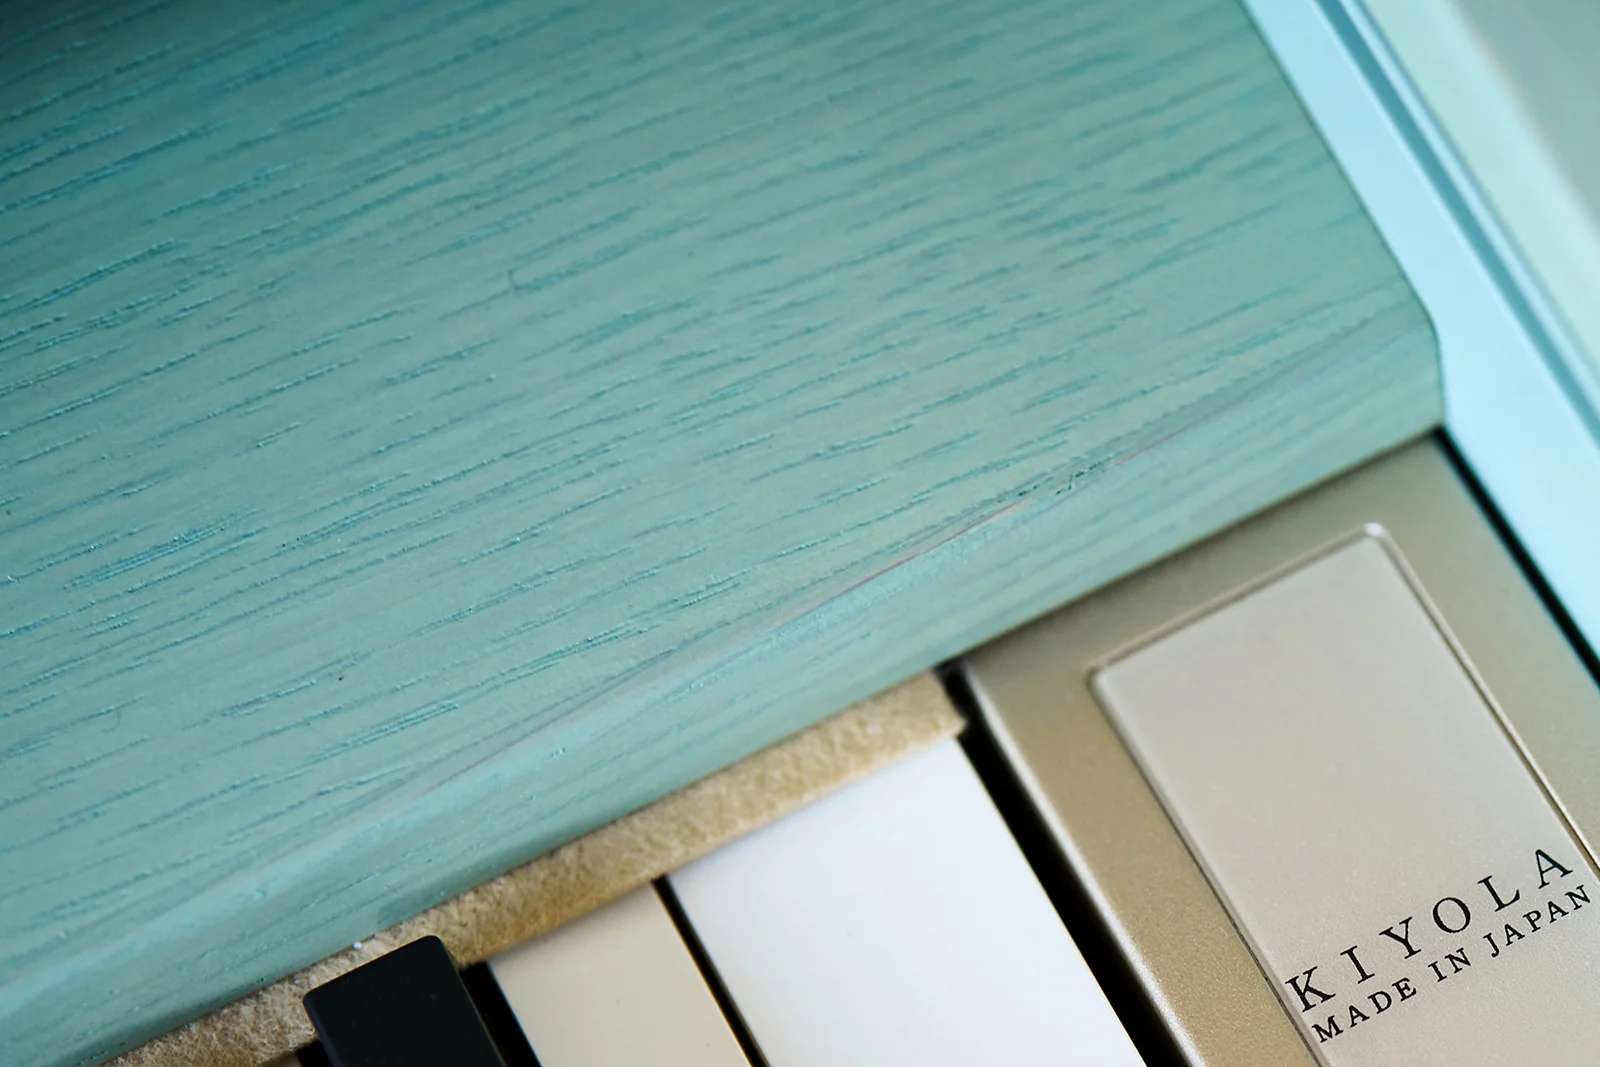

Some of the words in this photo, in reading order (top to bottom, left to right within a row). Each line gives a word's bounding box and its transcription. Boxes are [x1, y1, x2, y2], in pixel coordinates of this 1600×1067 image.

[1285, 848, 1573, 1013] KIYOLA
[1311, 977, 1417, 1043] MADE
[1427, 947, 1471, 983] IN
[1483, 884, 1592, 958] JAPAN
